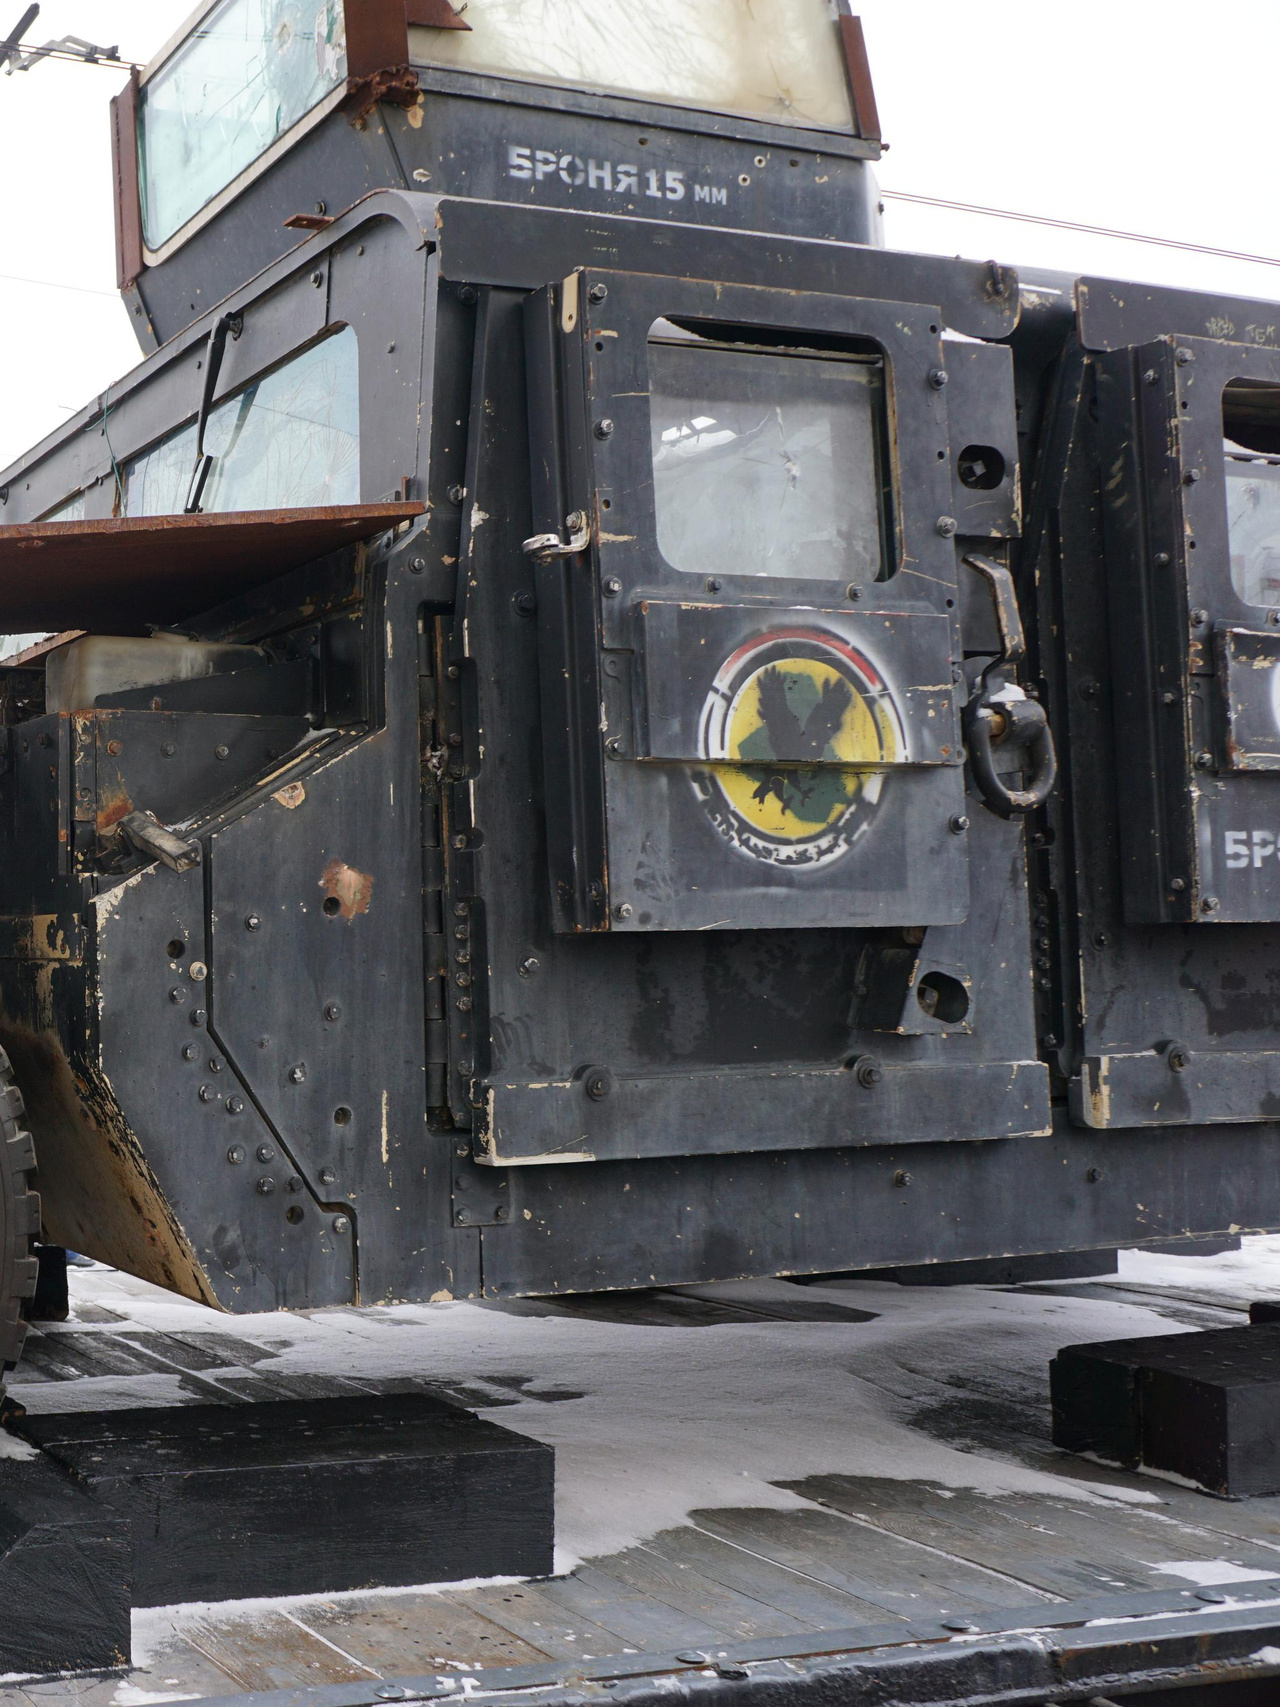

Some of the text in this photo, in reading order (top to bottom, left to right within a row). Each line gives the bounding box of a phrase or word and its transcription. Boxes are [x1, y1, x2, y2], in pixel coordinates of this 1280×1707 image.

[507, 145, 639, 195] БРОНЯ
[645, 169, 685, 201] 15
[1224, 830, 1280, 868] БР
